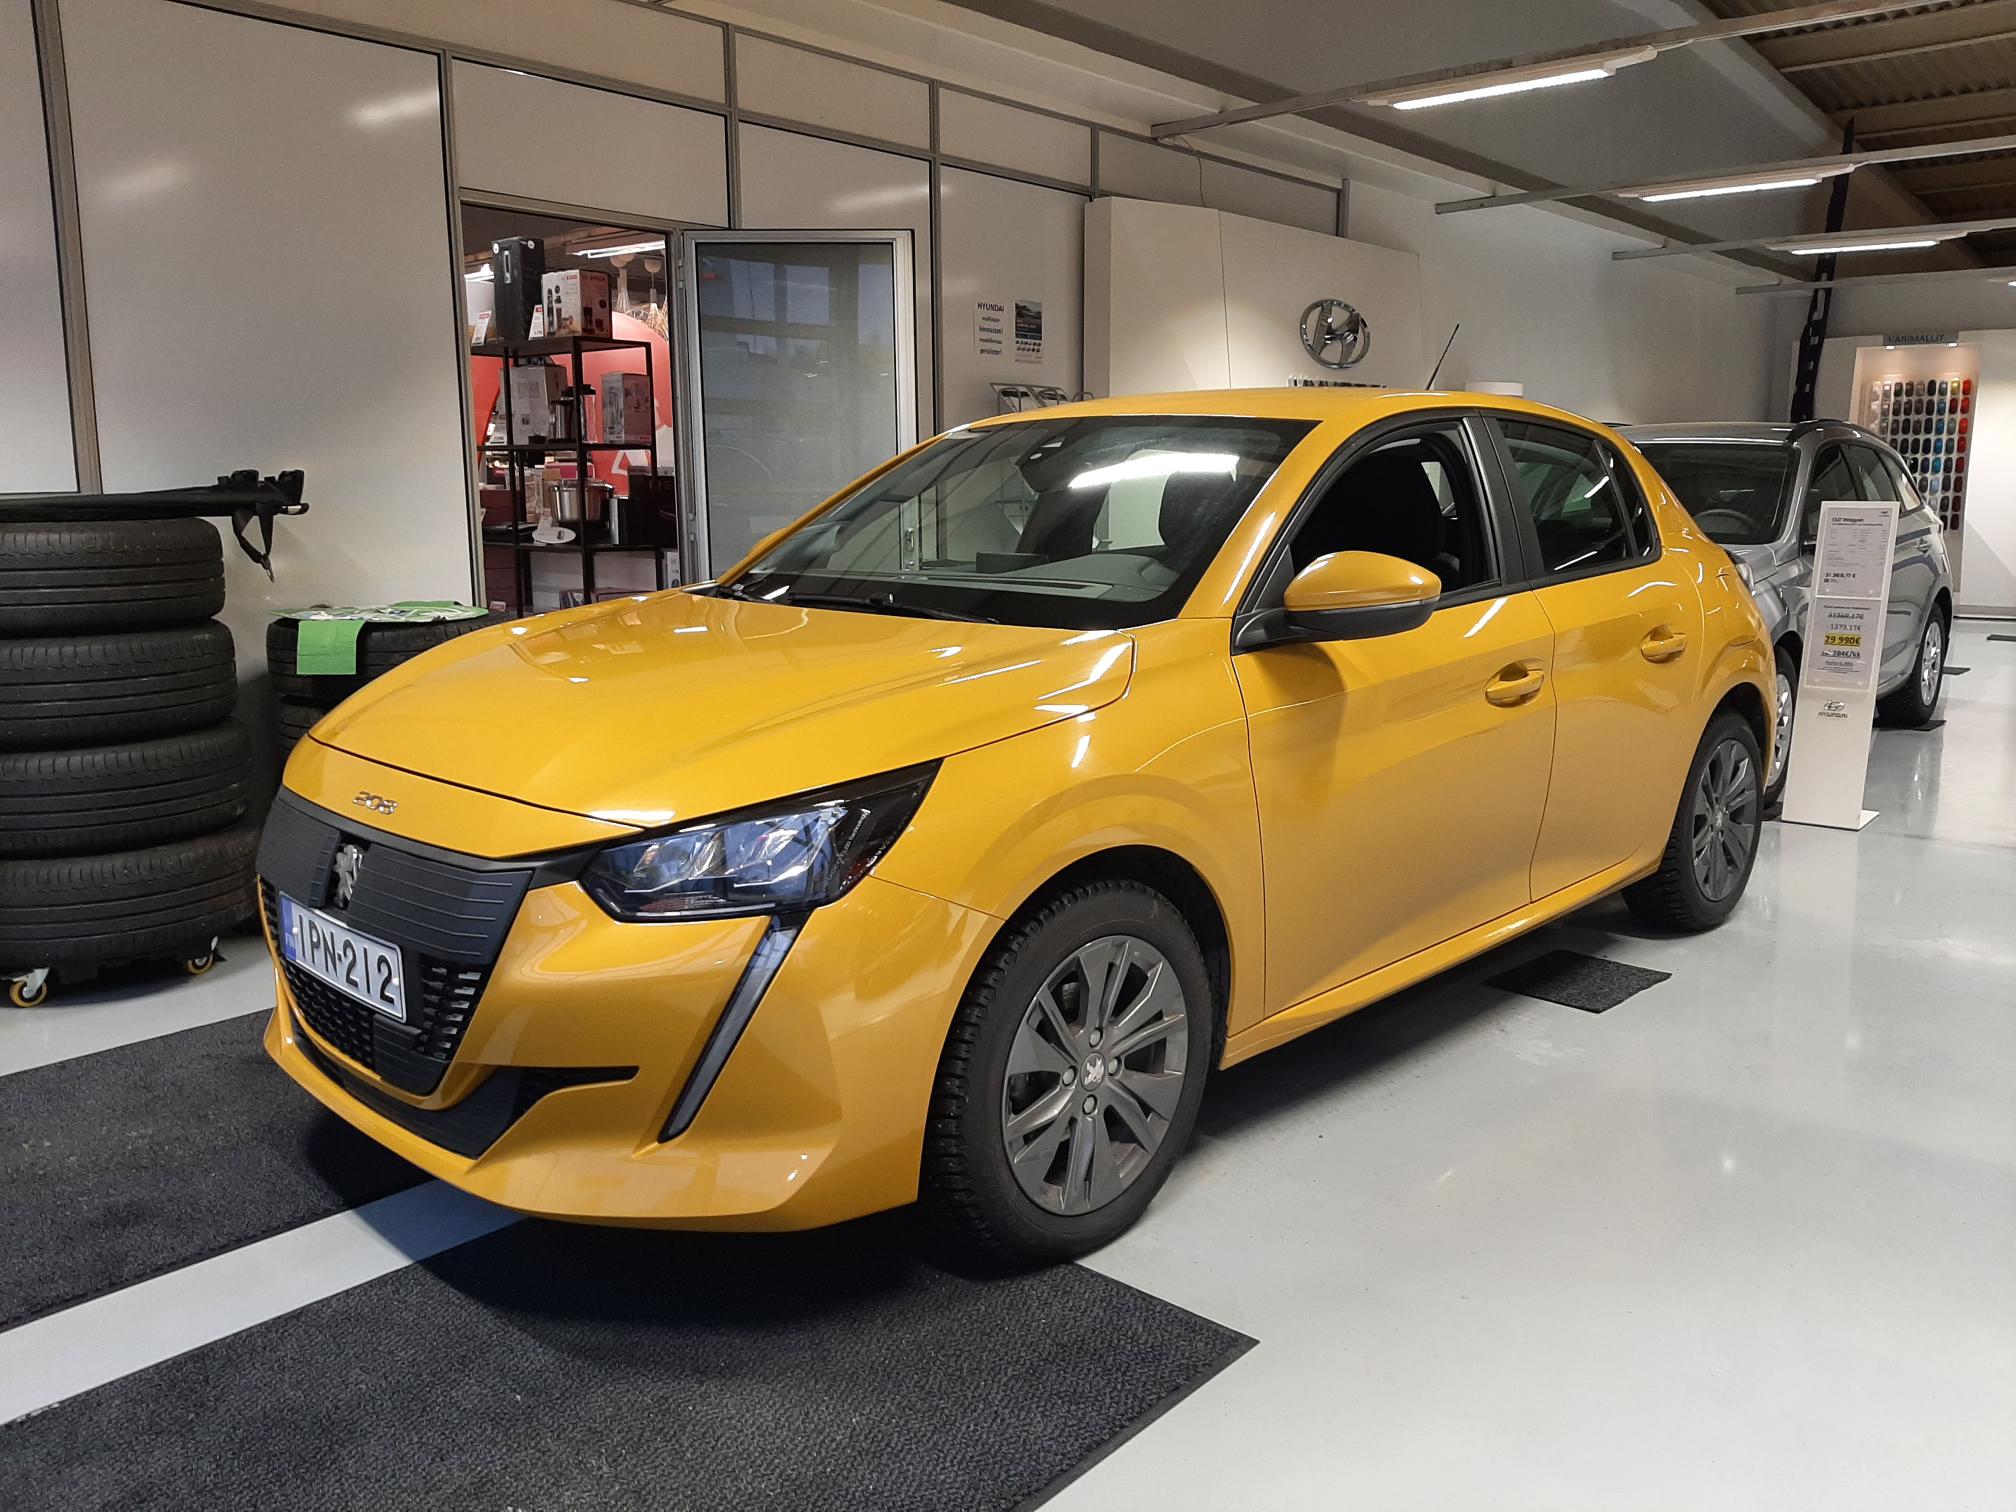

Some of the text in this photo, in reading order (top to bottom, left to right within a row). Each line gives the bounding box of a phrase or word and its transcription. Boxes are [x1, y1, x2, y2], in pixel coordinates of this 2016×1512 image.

[977, 302, 1005, 312] HYUNDAI
[1824, 635, 1836, 643] 29
[298, 914, 395, 1005] IPN-212
